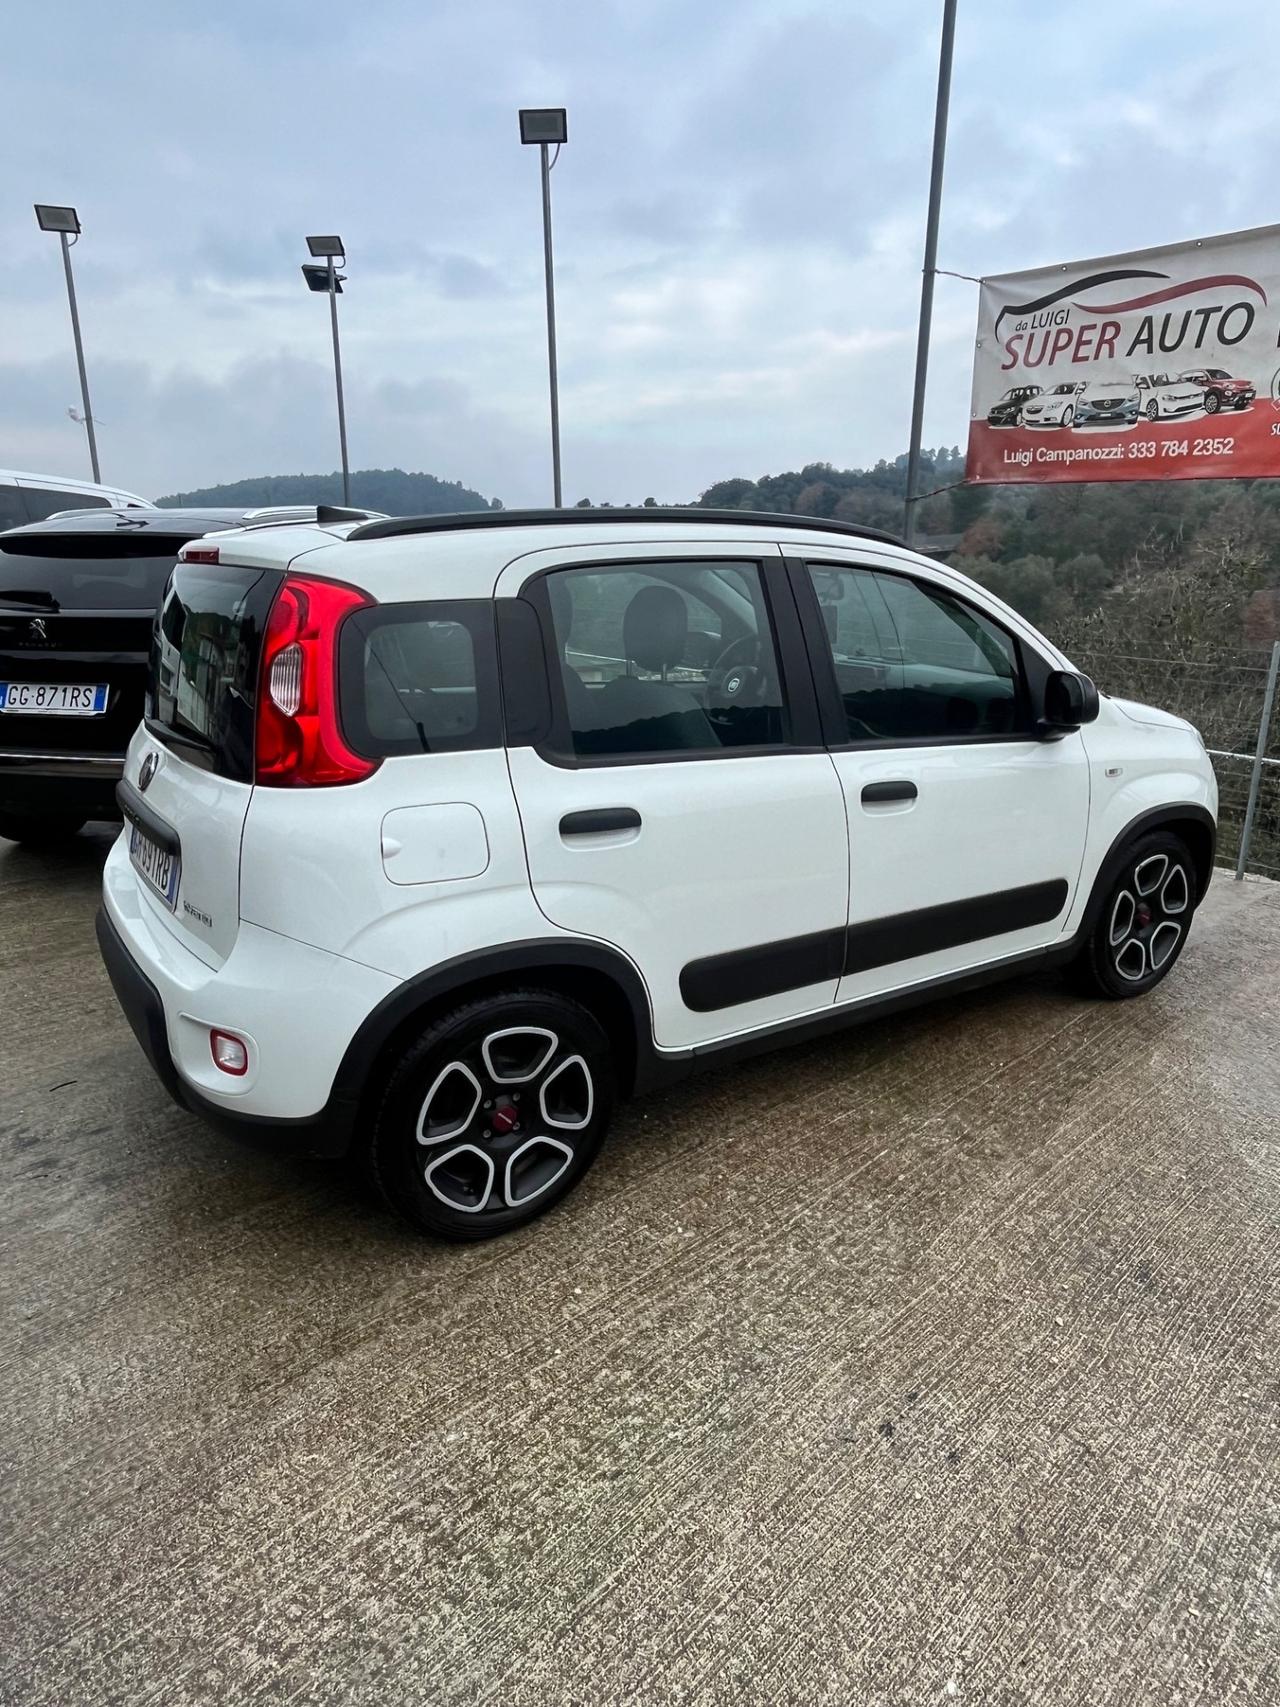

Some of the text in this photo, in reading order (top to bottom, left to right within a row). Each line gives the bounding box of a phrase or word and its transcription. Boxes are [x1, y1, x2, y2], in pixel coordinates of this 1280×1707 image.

[1015, 308, 1070, 332] da LUIGI
[1001, 320, 1122, 371] SUPER
[1126, 301, 1256, 357] AUTO
[1004, 437, 1235, 467] Luigi Campanozzi: 333 784 2352
